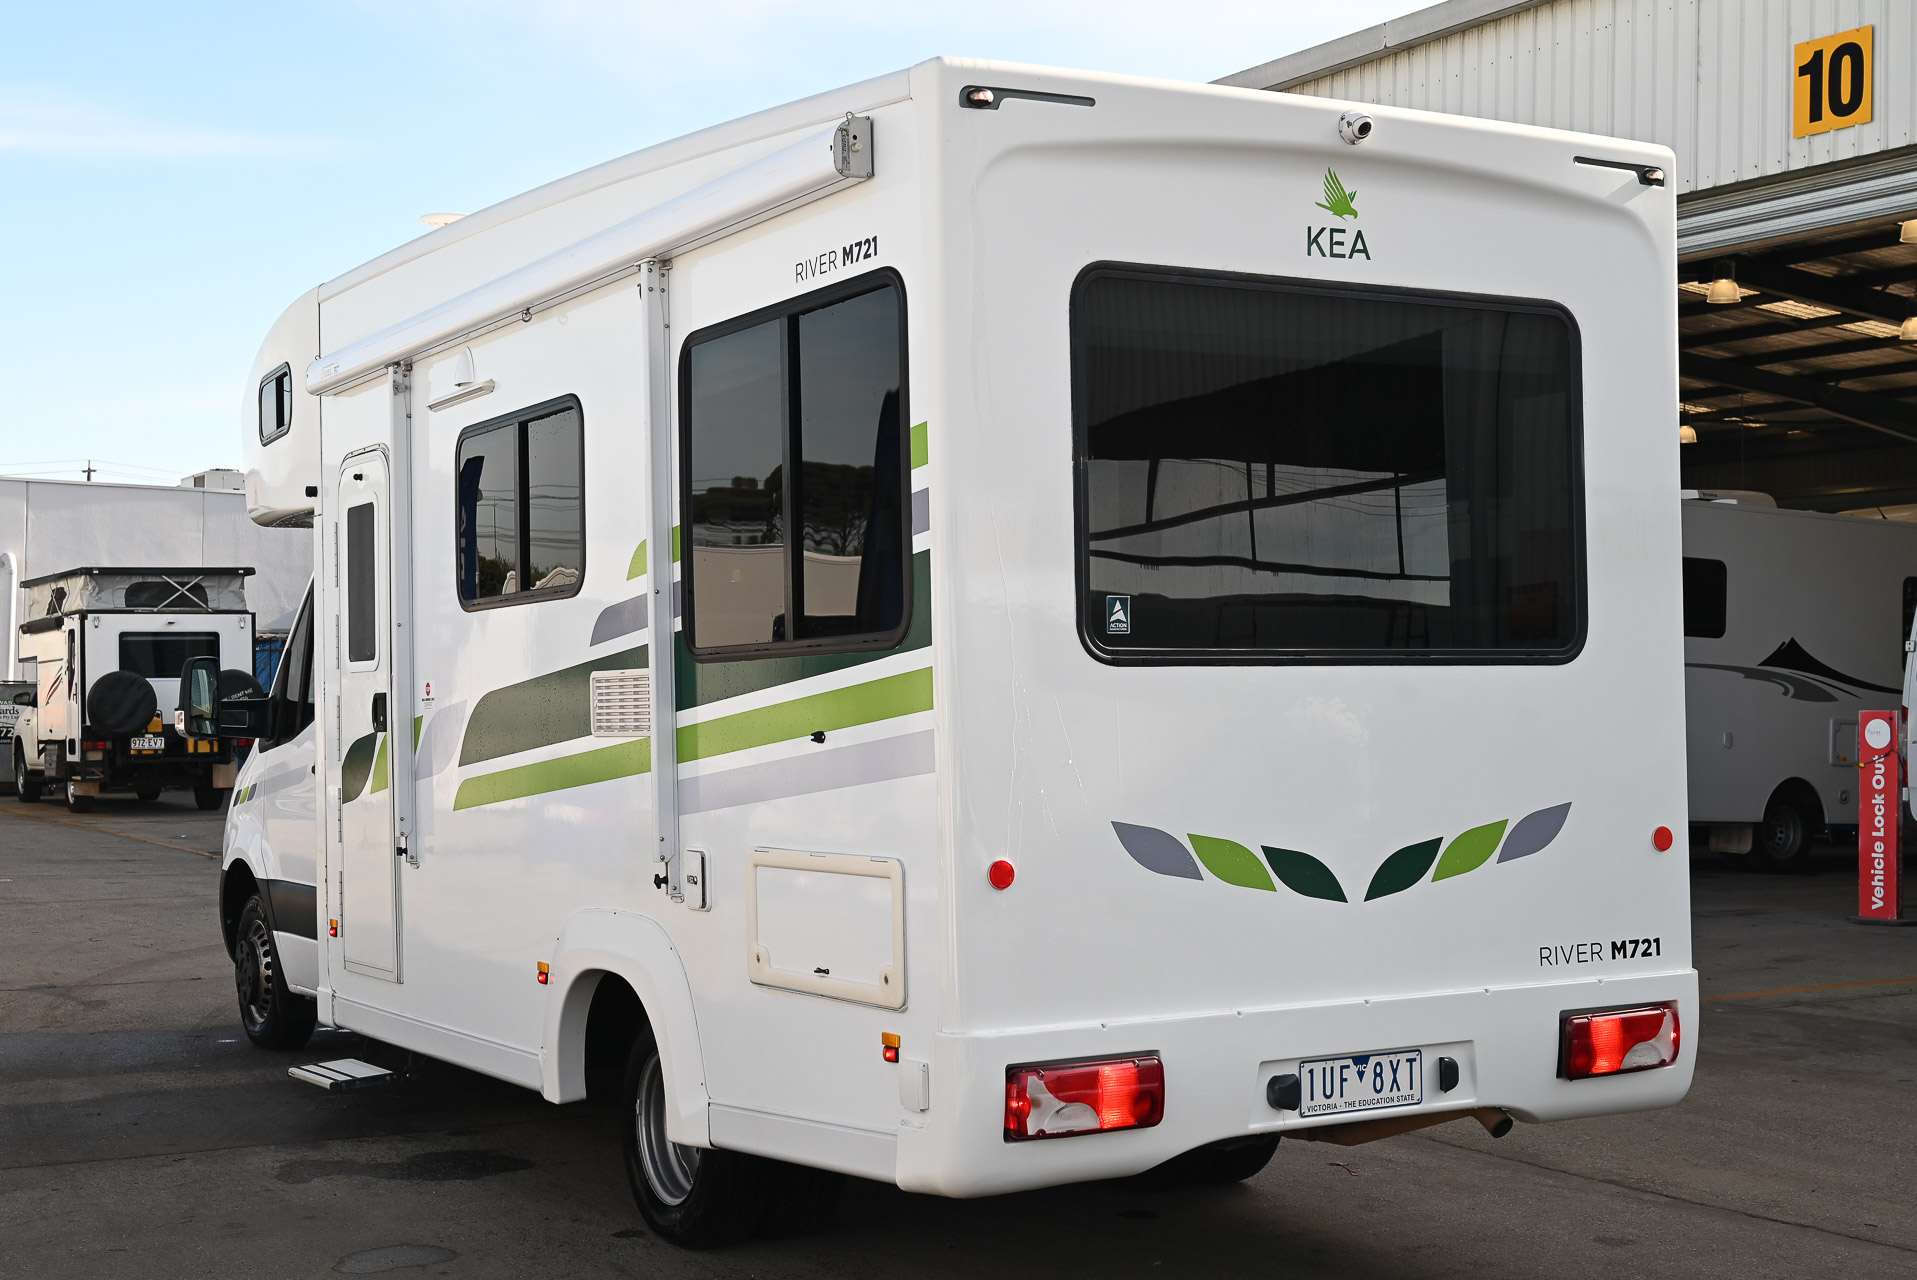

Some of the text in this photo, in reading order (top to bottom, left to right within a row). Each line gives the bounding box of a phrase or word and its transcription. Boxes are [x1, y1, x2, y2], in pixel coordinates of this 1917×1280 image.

[1798, 42, 1865, 123] 10
[795, 235, 878, 283] RIVER M721
[1307, 226, 1371, 260] KEA
[1871, 754, 1885, 910] Vehicle Lock Out
[1540, 937, 1661, 967] RIVER M721
[1355, 1064, 1367, 1072] VIC
[1306, 1103, 1338, 1112] VICTORIA
[1344, 1100, 1357, 1109] THE
[1359, 1095, 1395, 1107] EDUCATION
[1396, 1093, 1415, 1103] STATE
